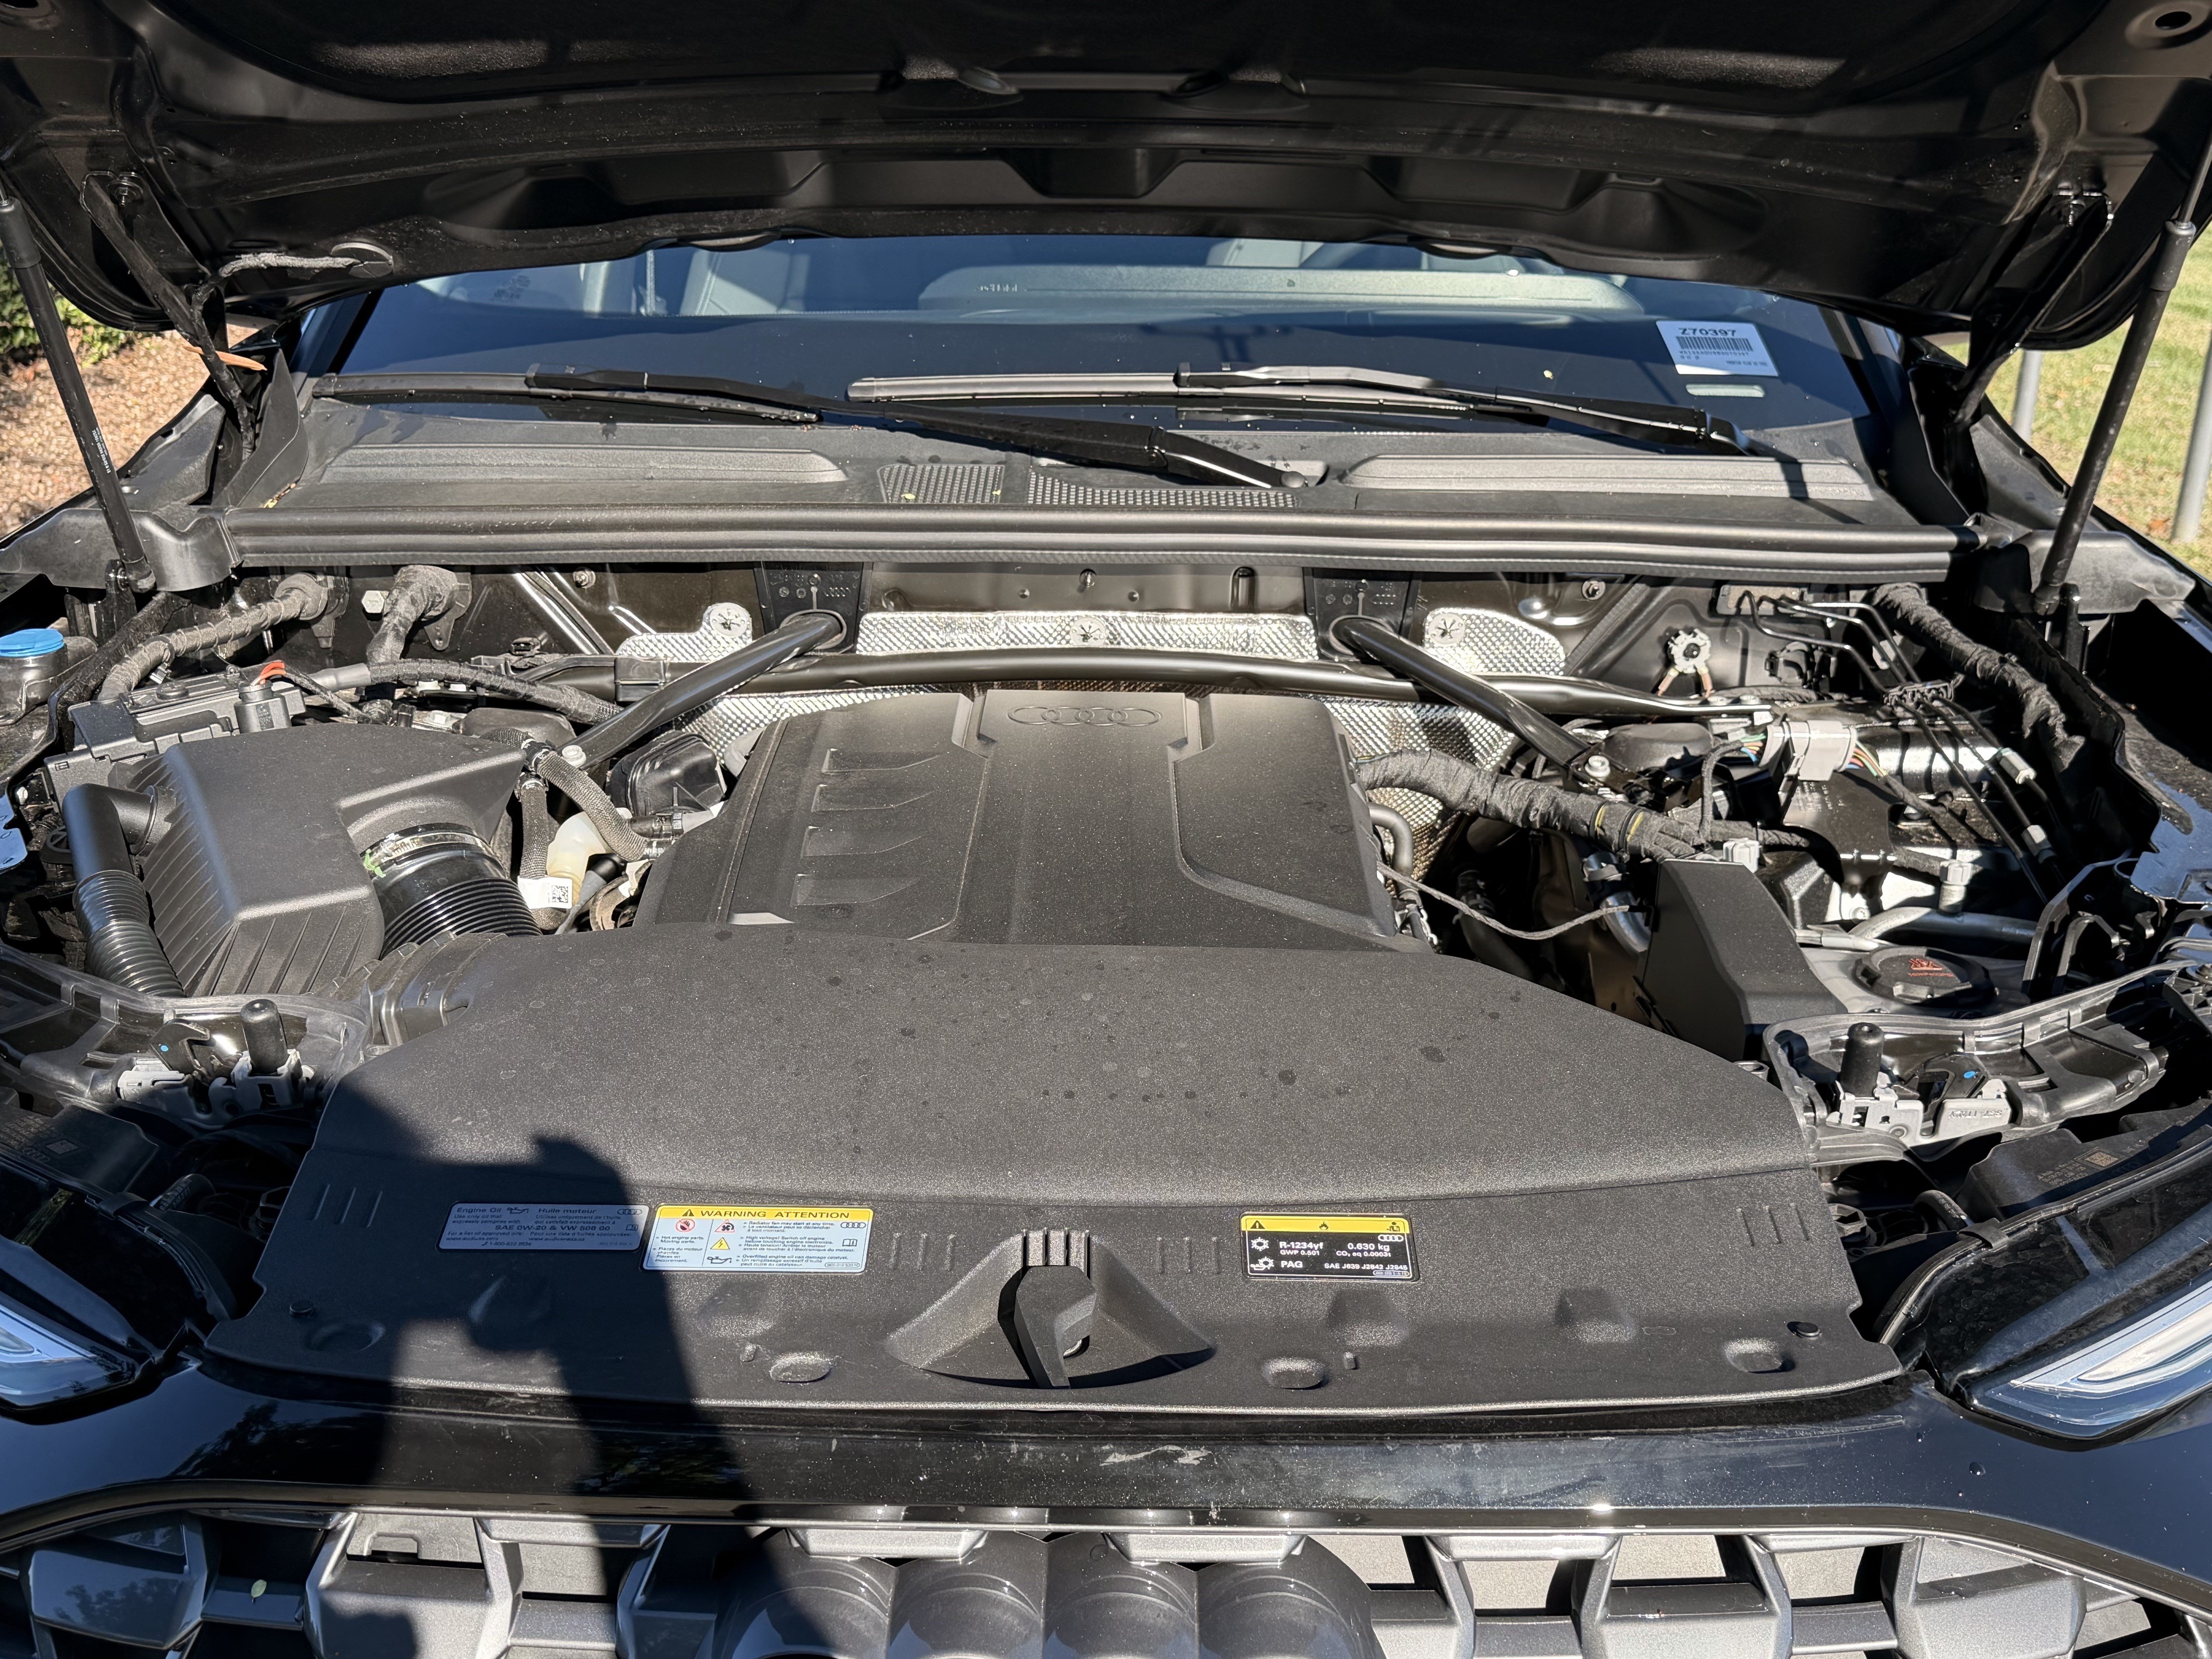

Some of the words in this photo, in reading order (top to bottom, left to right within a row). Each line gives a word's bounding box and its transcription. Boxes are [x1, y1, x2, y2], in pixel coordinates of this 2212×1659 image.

[1679, 328, 1736, 336] Z70397
[700, 1209, 766, 1218] WARNING
[1378, 1243, 1390, 1251] kg
